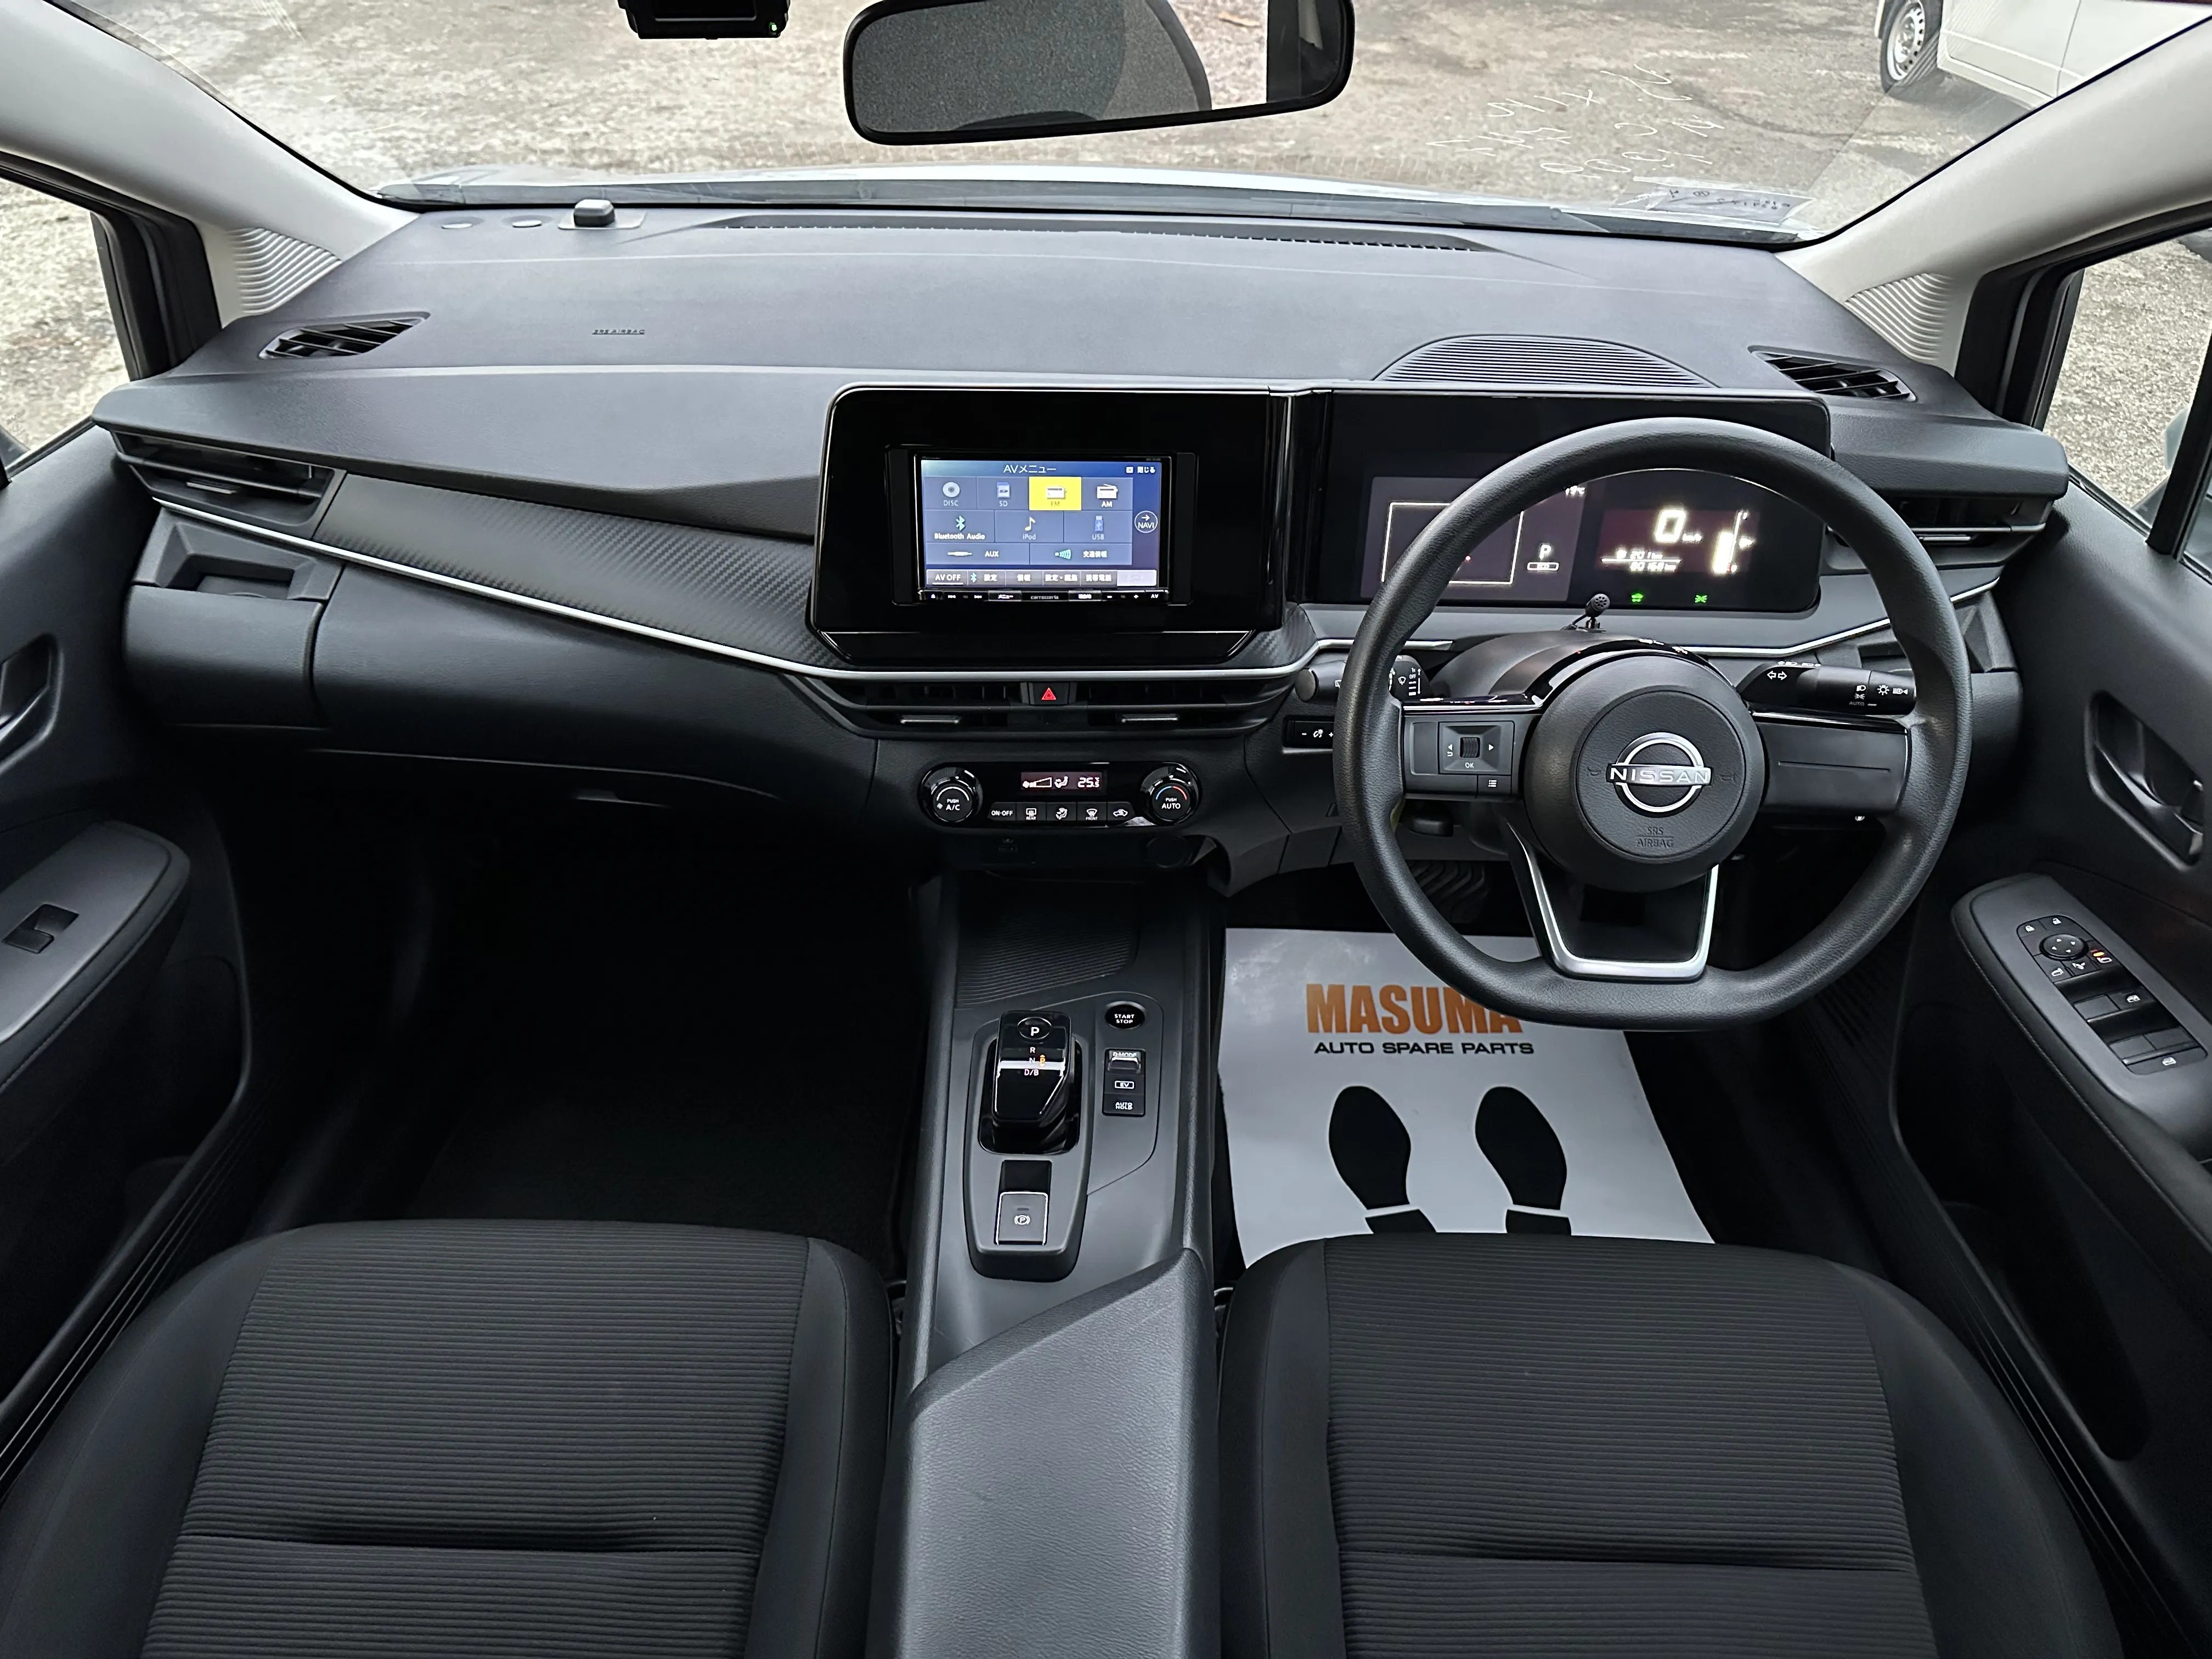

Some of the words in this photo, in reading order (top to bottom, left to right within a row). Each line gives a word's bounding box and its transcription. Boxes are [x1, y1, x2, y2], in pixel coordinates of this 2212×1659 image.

[1003, 464, 1057, 473] AVメニュー
[1655, 509, 1686, 542] 0
[1539, 544, 1551, 560] P
[1610, 767, 1709, 783] NISSAN
[1647, 826, 1664, 835] SRS
[1637, 838, 1674, 848] AIRBAG
[1031, 1026, 1040, 1036] P
[1314, 1042, 1375, 1054] AUTO
[1382, 1042, 1454, 1054] SPARE
[1461, 1042, 1534, 1054] PARTS
